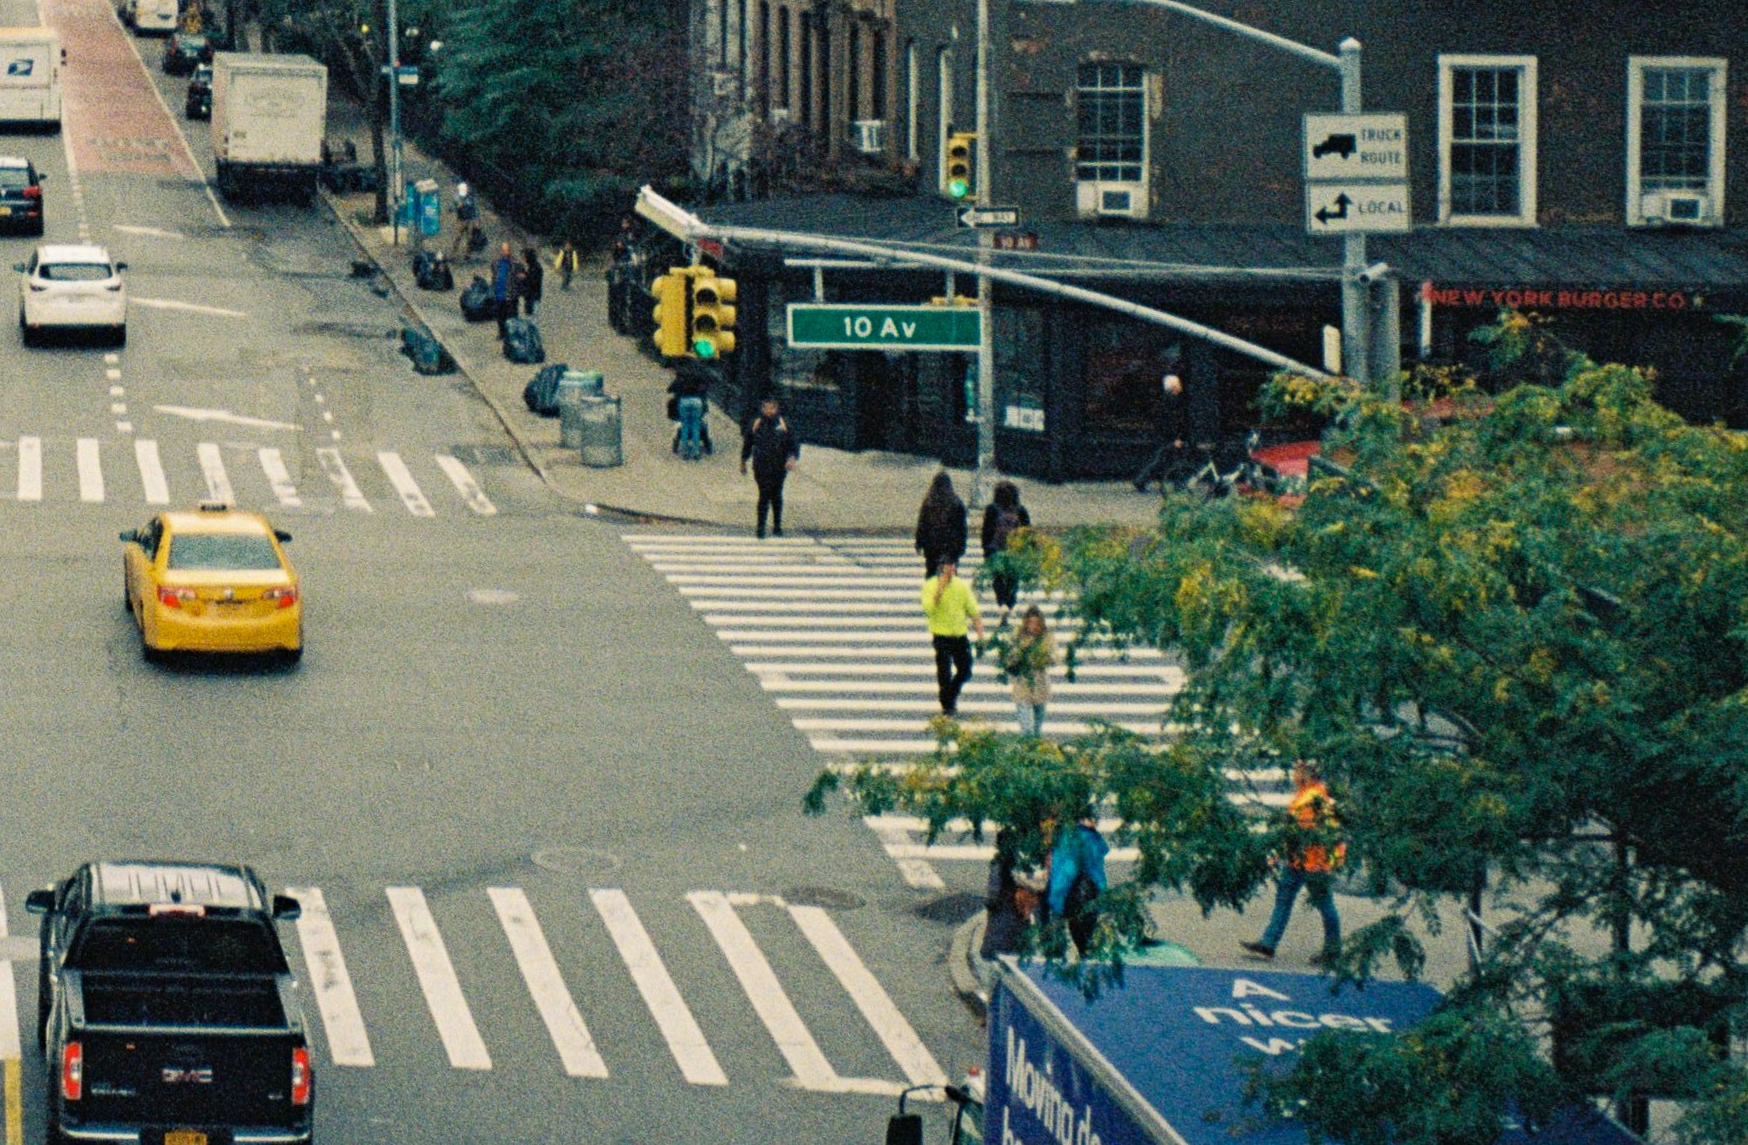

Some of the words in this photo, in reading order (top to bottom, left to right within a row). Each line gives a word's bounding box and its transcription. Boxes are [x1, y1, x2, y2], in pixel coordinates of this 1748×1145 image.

[1361, 129, 1402, 141] TRUCK
[1360, 151, 1401, 164] ROUTE
[1358, 201, 1403, 214] LOCAL
[1432, 290, 1484, 304] NEW
[1490, 290, 1551, 305] YORK
[1557, 291, 1647, 306] BURGER
[844, 316, 872, 338] 10
[879, 316, 916, 338] Av
[1232, 978, 1291, 1001] A
[1192, 1003, 1393, 1033] nicer
[1005, 1024, 1074, 1145] Moving
